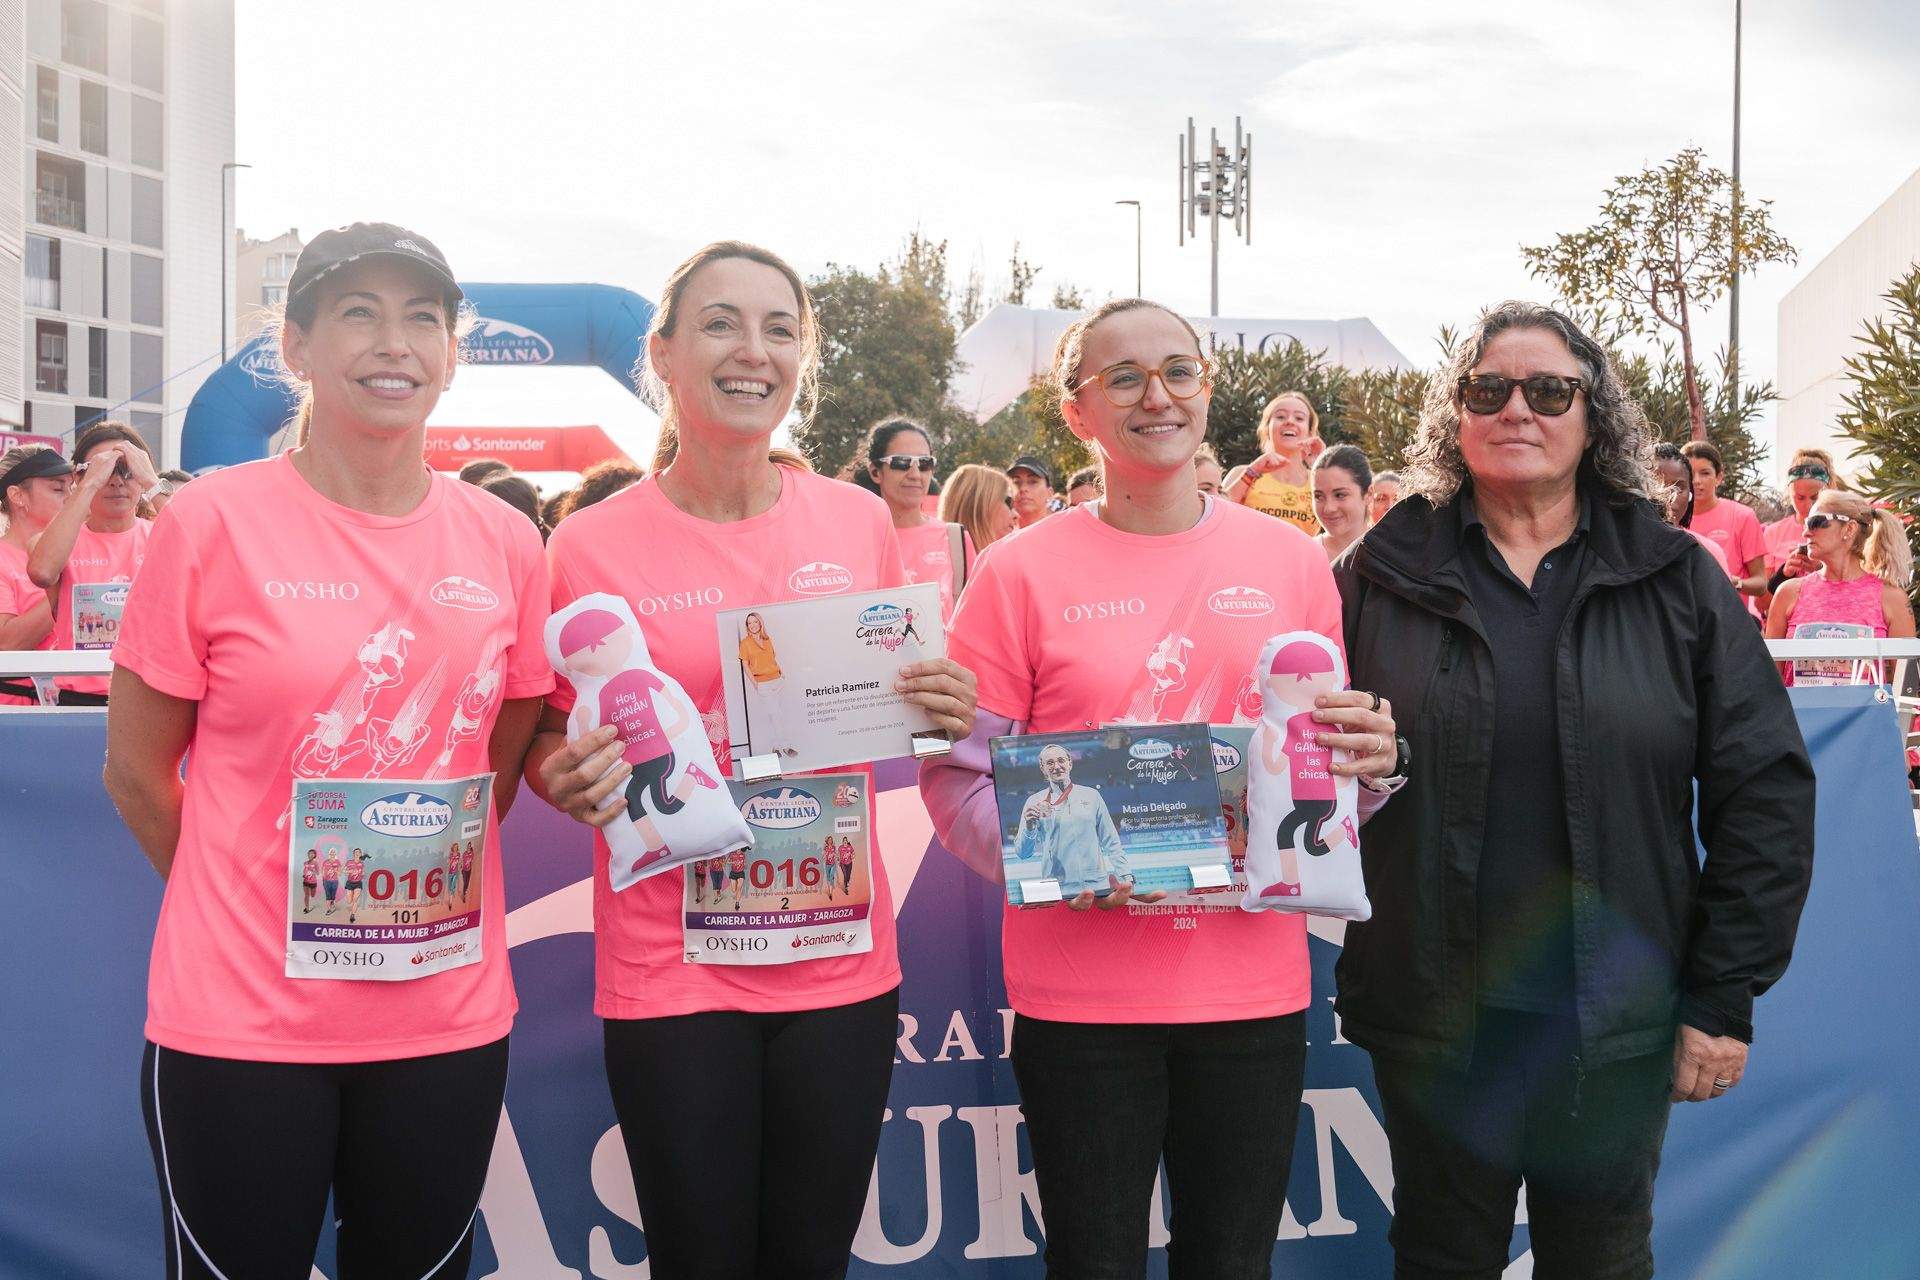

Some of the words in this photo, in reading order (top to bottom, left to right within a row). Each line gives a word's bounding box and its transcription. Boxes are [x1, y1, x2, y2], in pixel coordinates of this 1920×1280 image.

[424, 439, 451, 451] orts
[472, 437, 545, 451] Santander
[264, 580, 360, 600] OYSHO
[796, 575, 850, 591] ASTURIANA
[437, 588, 495, 605] ASTURIANA
[638, 586, 724, 616] OYSHO
[1214, 599, 1270, 610] ASTURIANA
[863, 613, 900, 623] ASTURIANA
[1064, 598, 1145, 623] OYSHO
[856, 626, 893, 638] Carrera
[879, 634, 905, 652] Mujer
[805, 685, 840, 698] Patricia
[842, 680, 880, 692] Ramírez
[615, 690, 636, 706] Hoy
[611, 698, 648, 723] GANAN
[624, 720, 642, 732] las
[624, 727, 656, 746] chicas
[1127, 759, 1164, 770] Carrera
[1306, 756, 1320, 766] las
[1150, 768, 1179, 785] Mujer
[1298, 769, 1329, 780] chicas
[308, 800, 346, 809] SUMA
[746, 803, 817, 820] ASTURIANA
[1122, 803, 1149, 814] María
[1150, 800, 1187, 812] Delgado
[318, 816, 348, 824] Zaragoza
[367, 807, 448, 826] ASTURIANA
[750, 857, 821, 889] 016
[368, 868, 443, 900] 016
[781, 898, 789, 910] 2
[1129, 905, 1174, 916] CARRERA
[1176, 905, 1189, 914] DE
[1191, 905, 1203, 914] LA
[391, 910, 419, 923] 101
[704, 916, 746, 926] CARRERA
[749, 916, 762, 925] DE
[764, 915, 776, 924] LA
[779, 913, 807, 924] MUJER
[813, 908, 853, 920] ZARAGOZA
[1173, 917, 1197, 930] 2024
[314, 928, 361, 938] CARRERA
[365, 929, 378, 939] DE
[381, 929, 394, 939] LA
[398, 927, 429, 939] MUJER
[434, 916, 469, 934] ZARAGOZA
[706, 936, 768, 951] OYSHO
[803, 932, 846, 947] Santande
[313, 949, 385, 967] OYSHO
[424, 942, 466, 962] Santander
